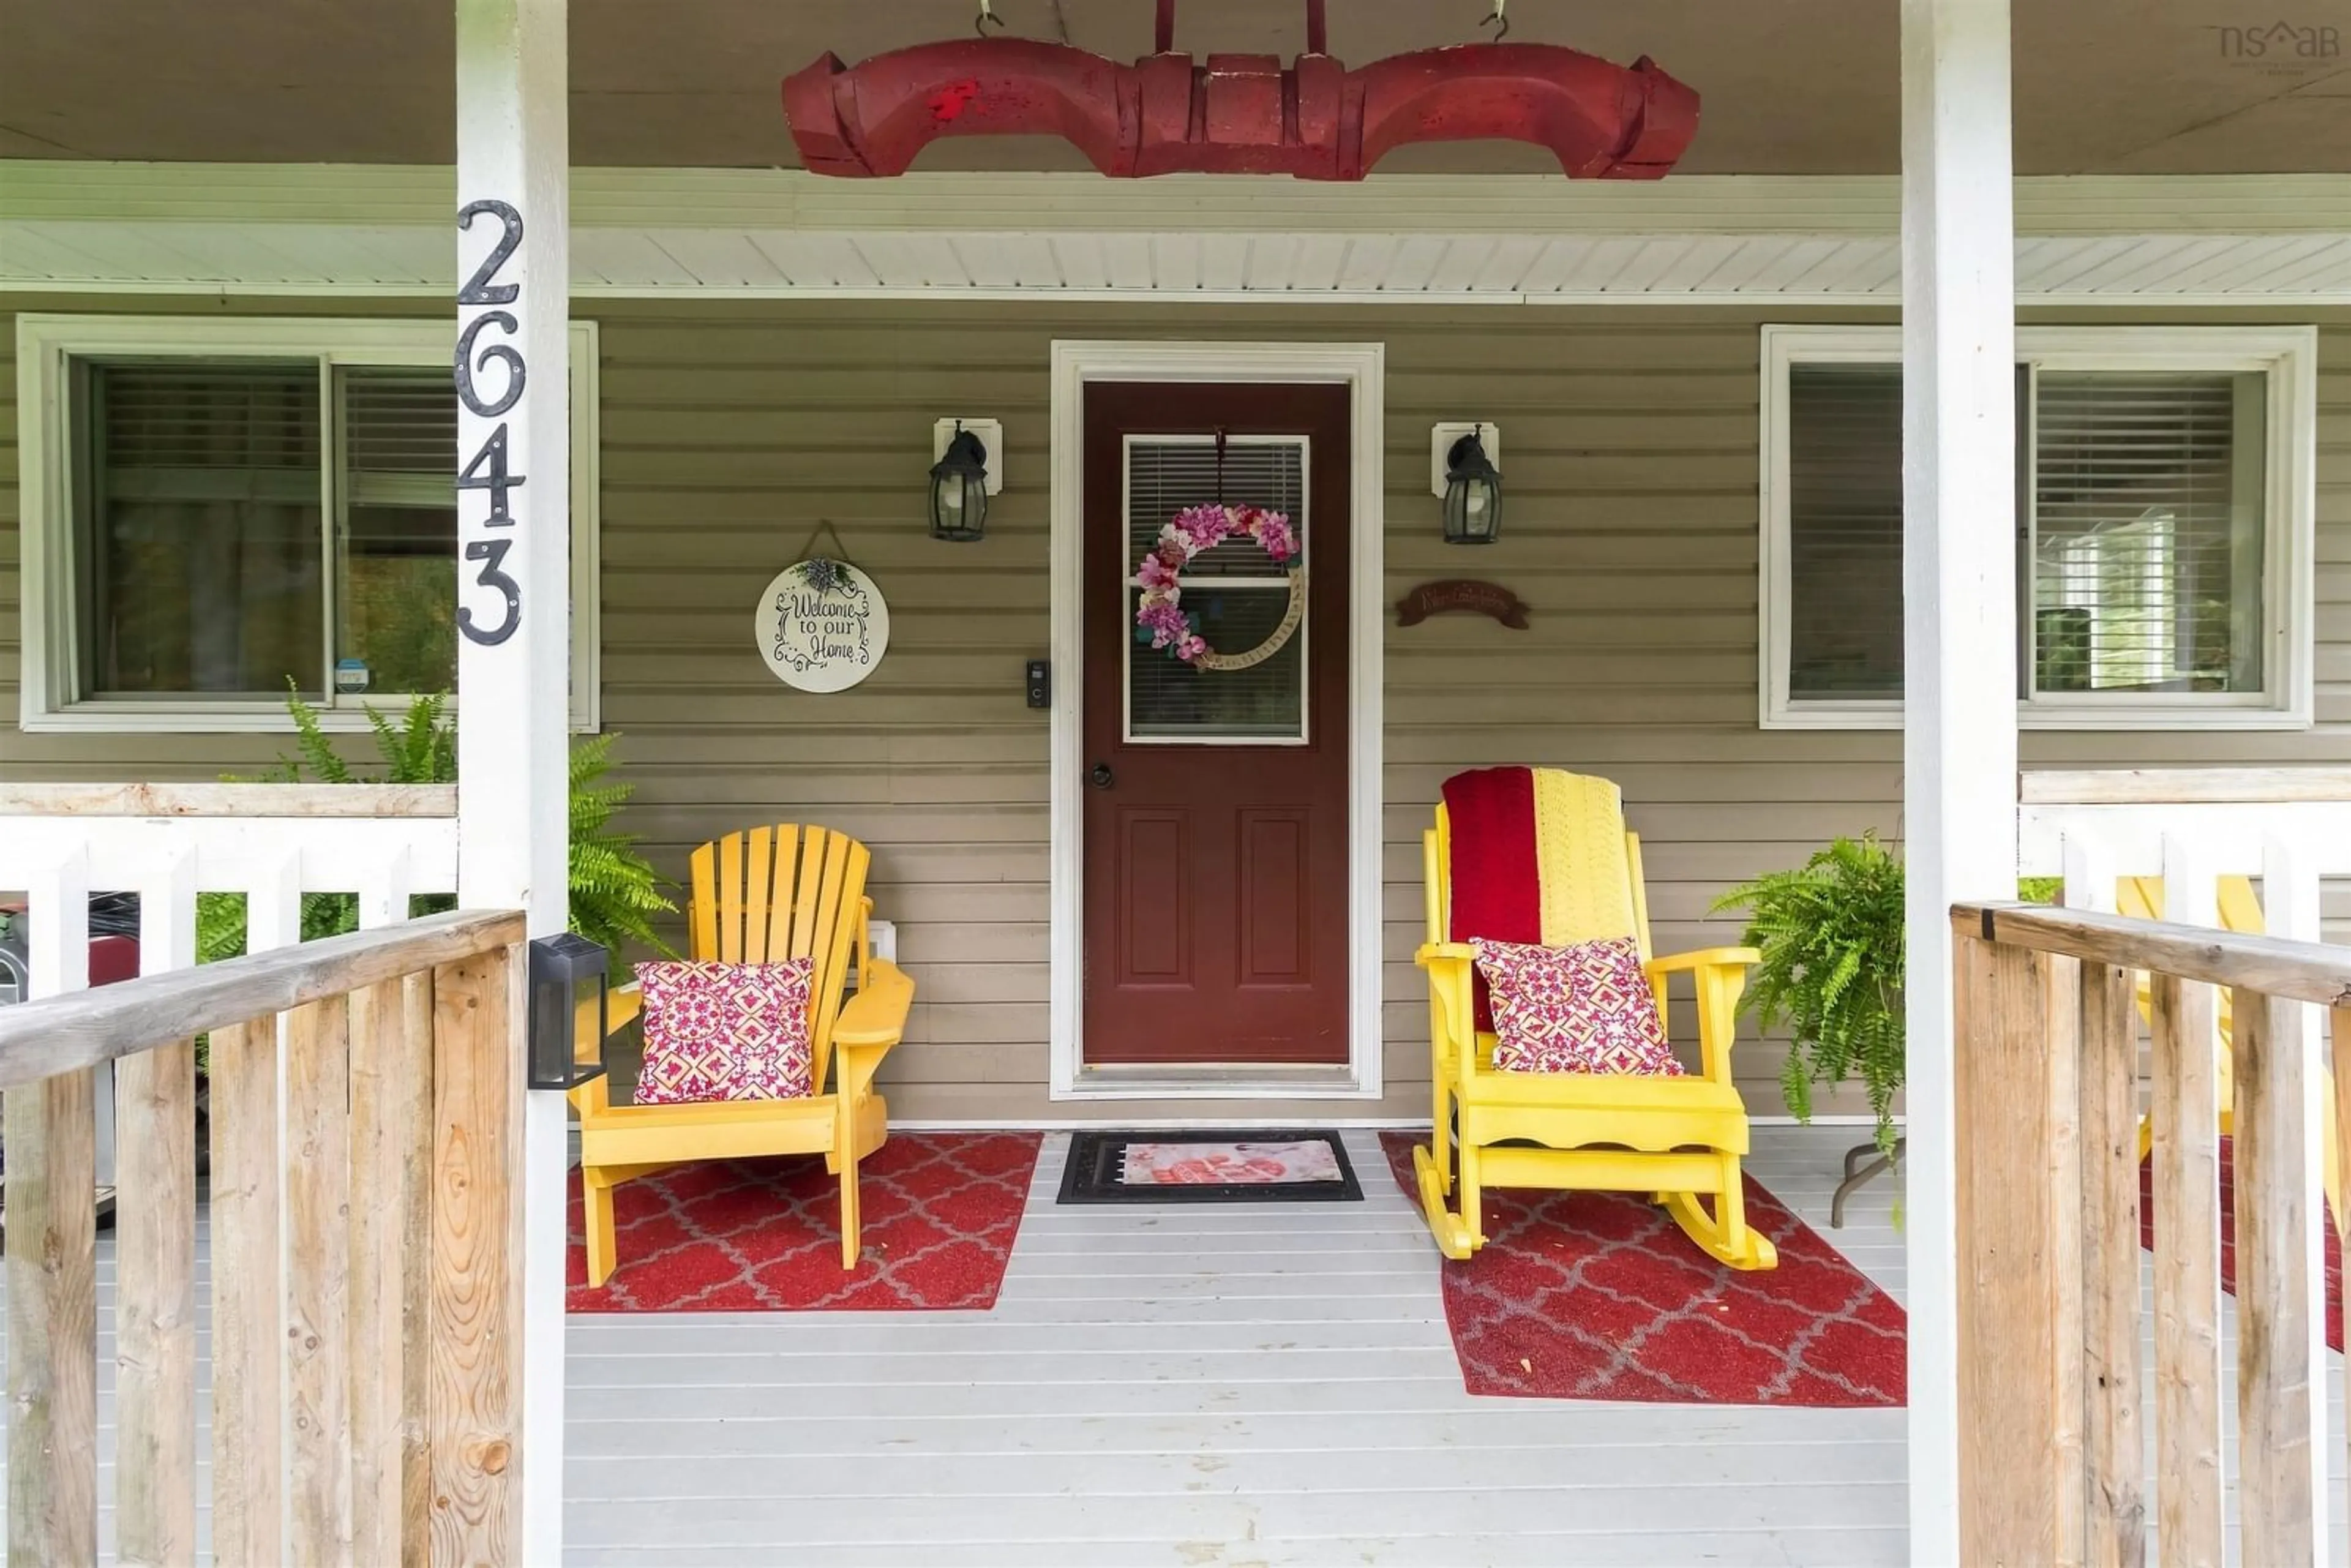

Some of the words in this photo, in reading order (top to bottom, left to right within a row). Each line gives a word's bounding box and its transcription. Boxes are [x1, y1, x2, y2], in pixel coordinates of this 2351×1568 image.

[454, 198, 527, 647] 2643
[791, 593, 855, 618] Welcome
[800, 621, 817, 634] to
[825, 621, 854, 634] our
[809, 635, 854, 659] Home
